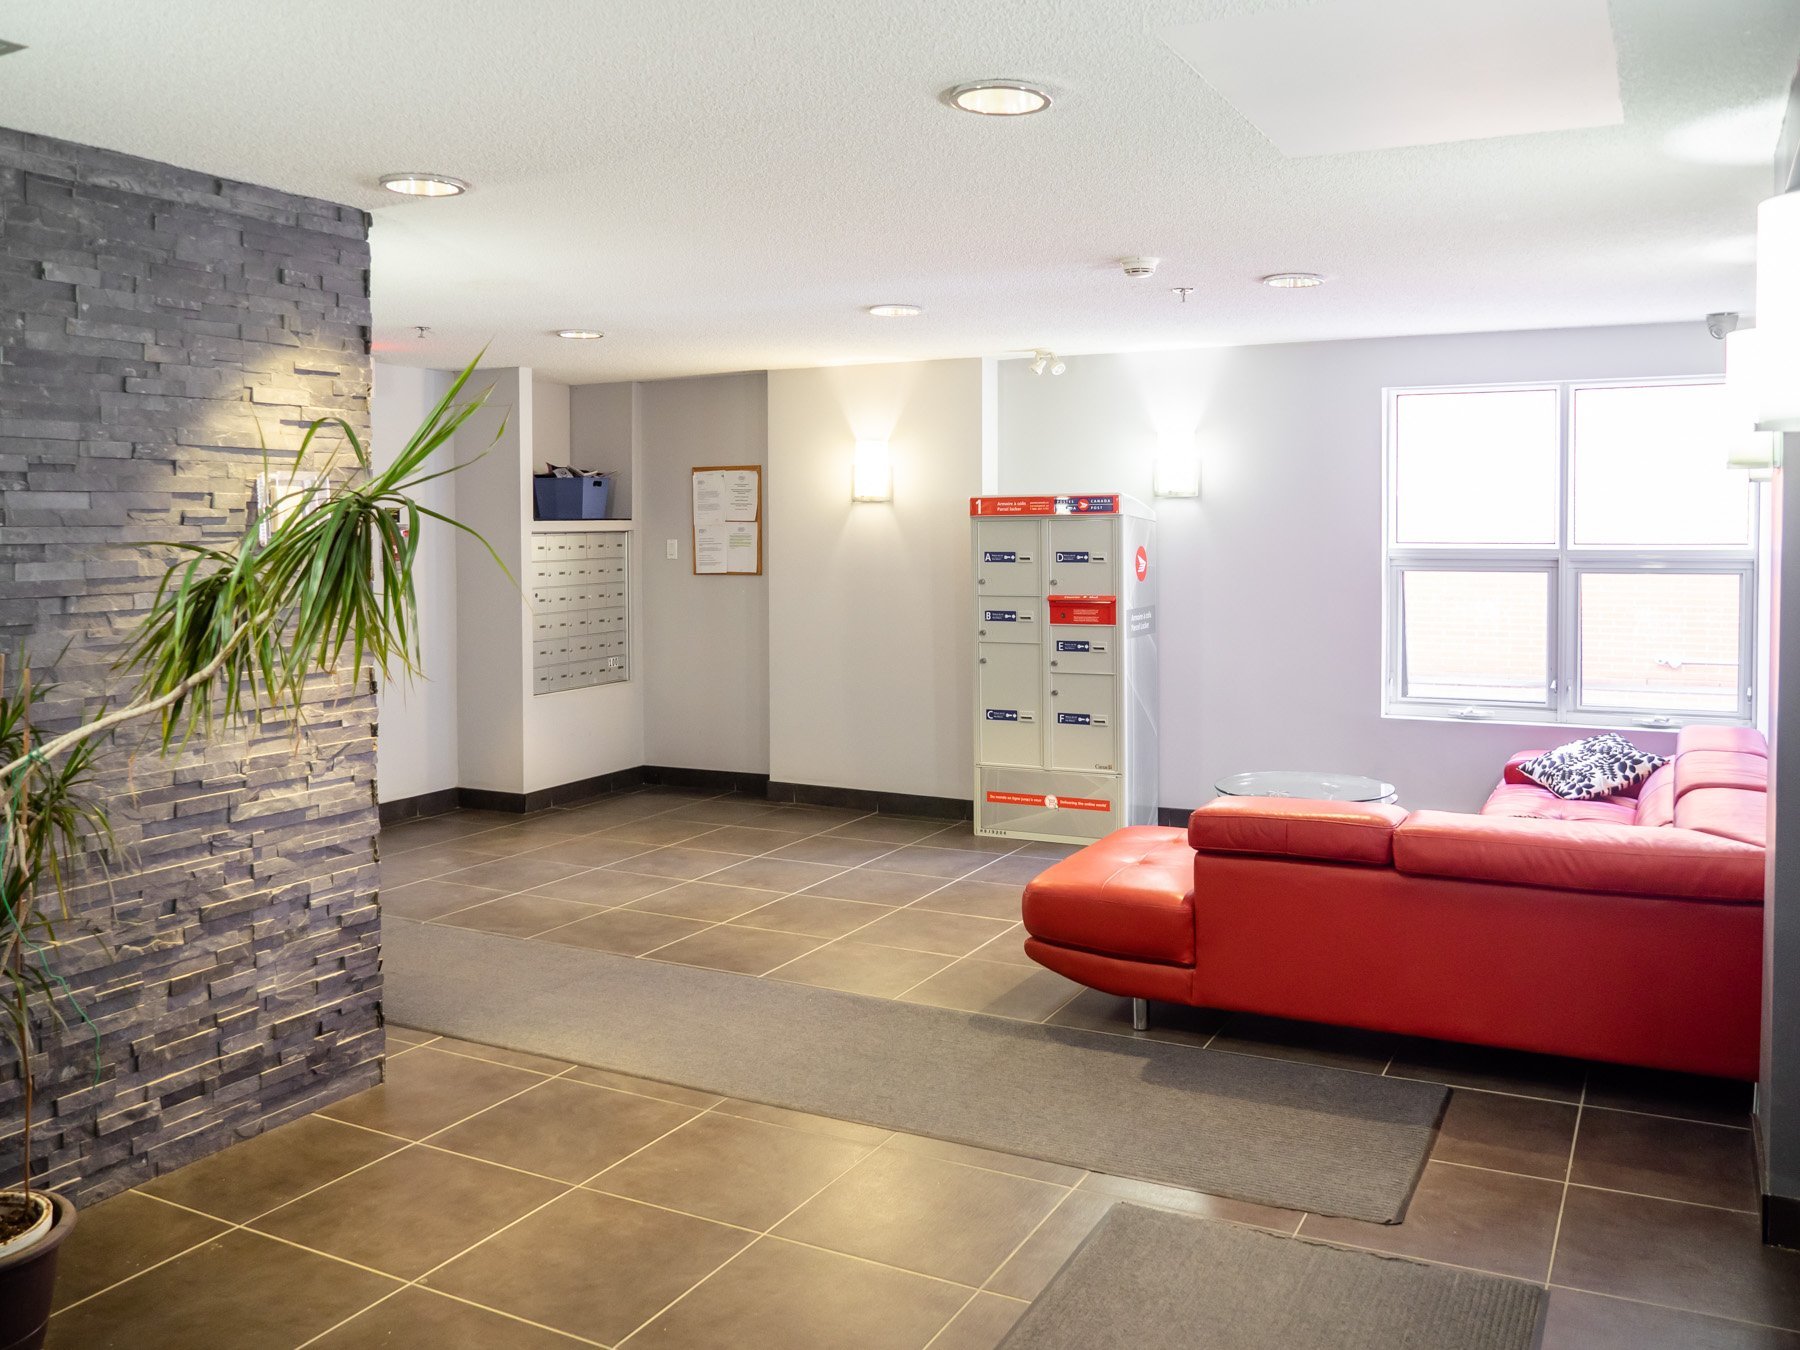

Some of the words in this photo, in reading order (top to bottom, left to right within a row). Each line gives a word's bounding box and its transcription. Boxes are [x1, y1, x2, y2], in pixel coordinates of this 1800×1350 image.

[975, 499, 982, 515] 1
[985, 553, 992, 561] A
[1056, 553, 1064, 562] D
[986, 611, 992, 620] B
[1058, 641, 1064, 651] E
[987, 710, 994, 719] C
[1059, 714, 1065, 723] F
